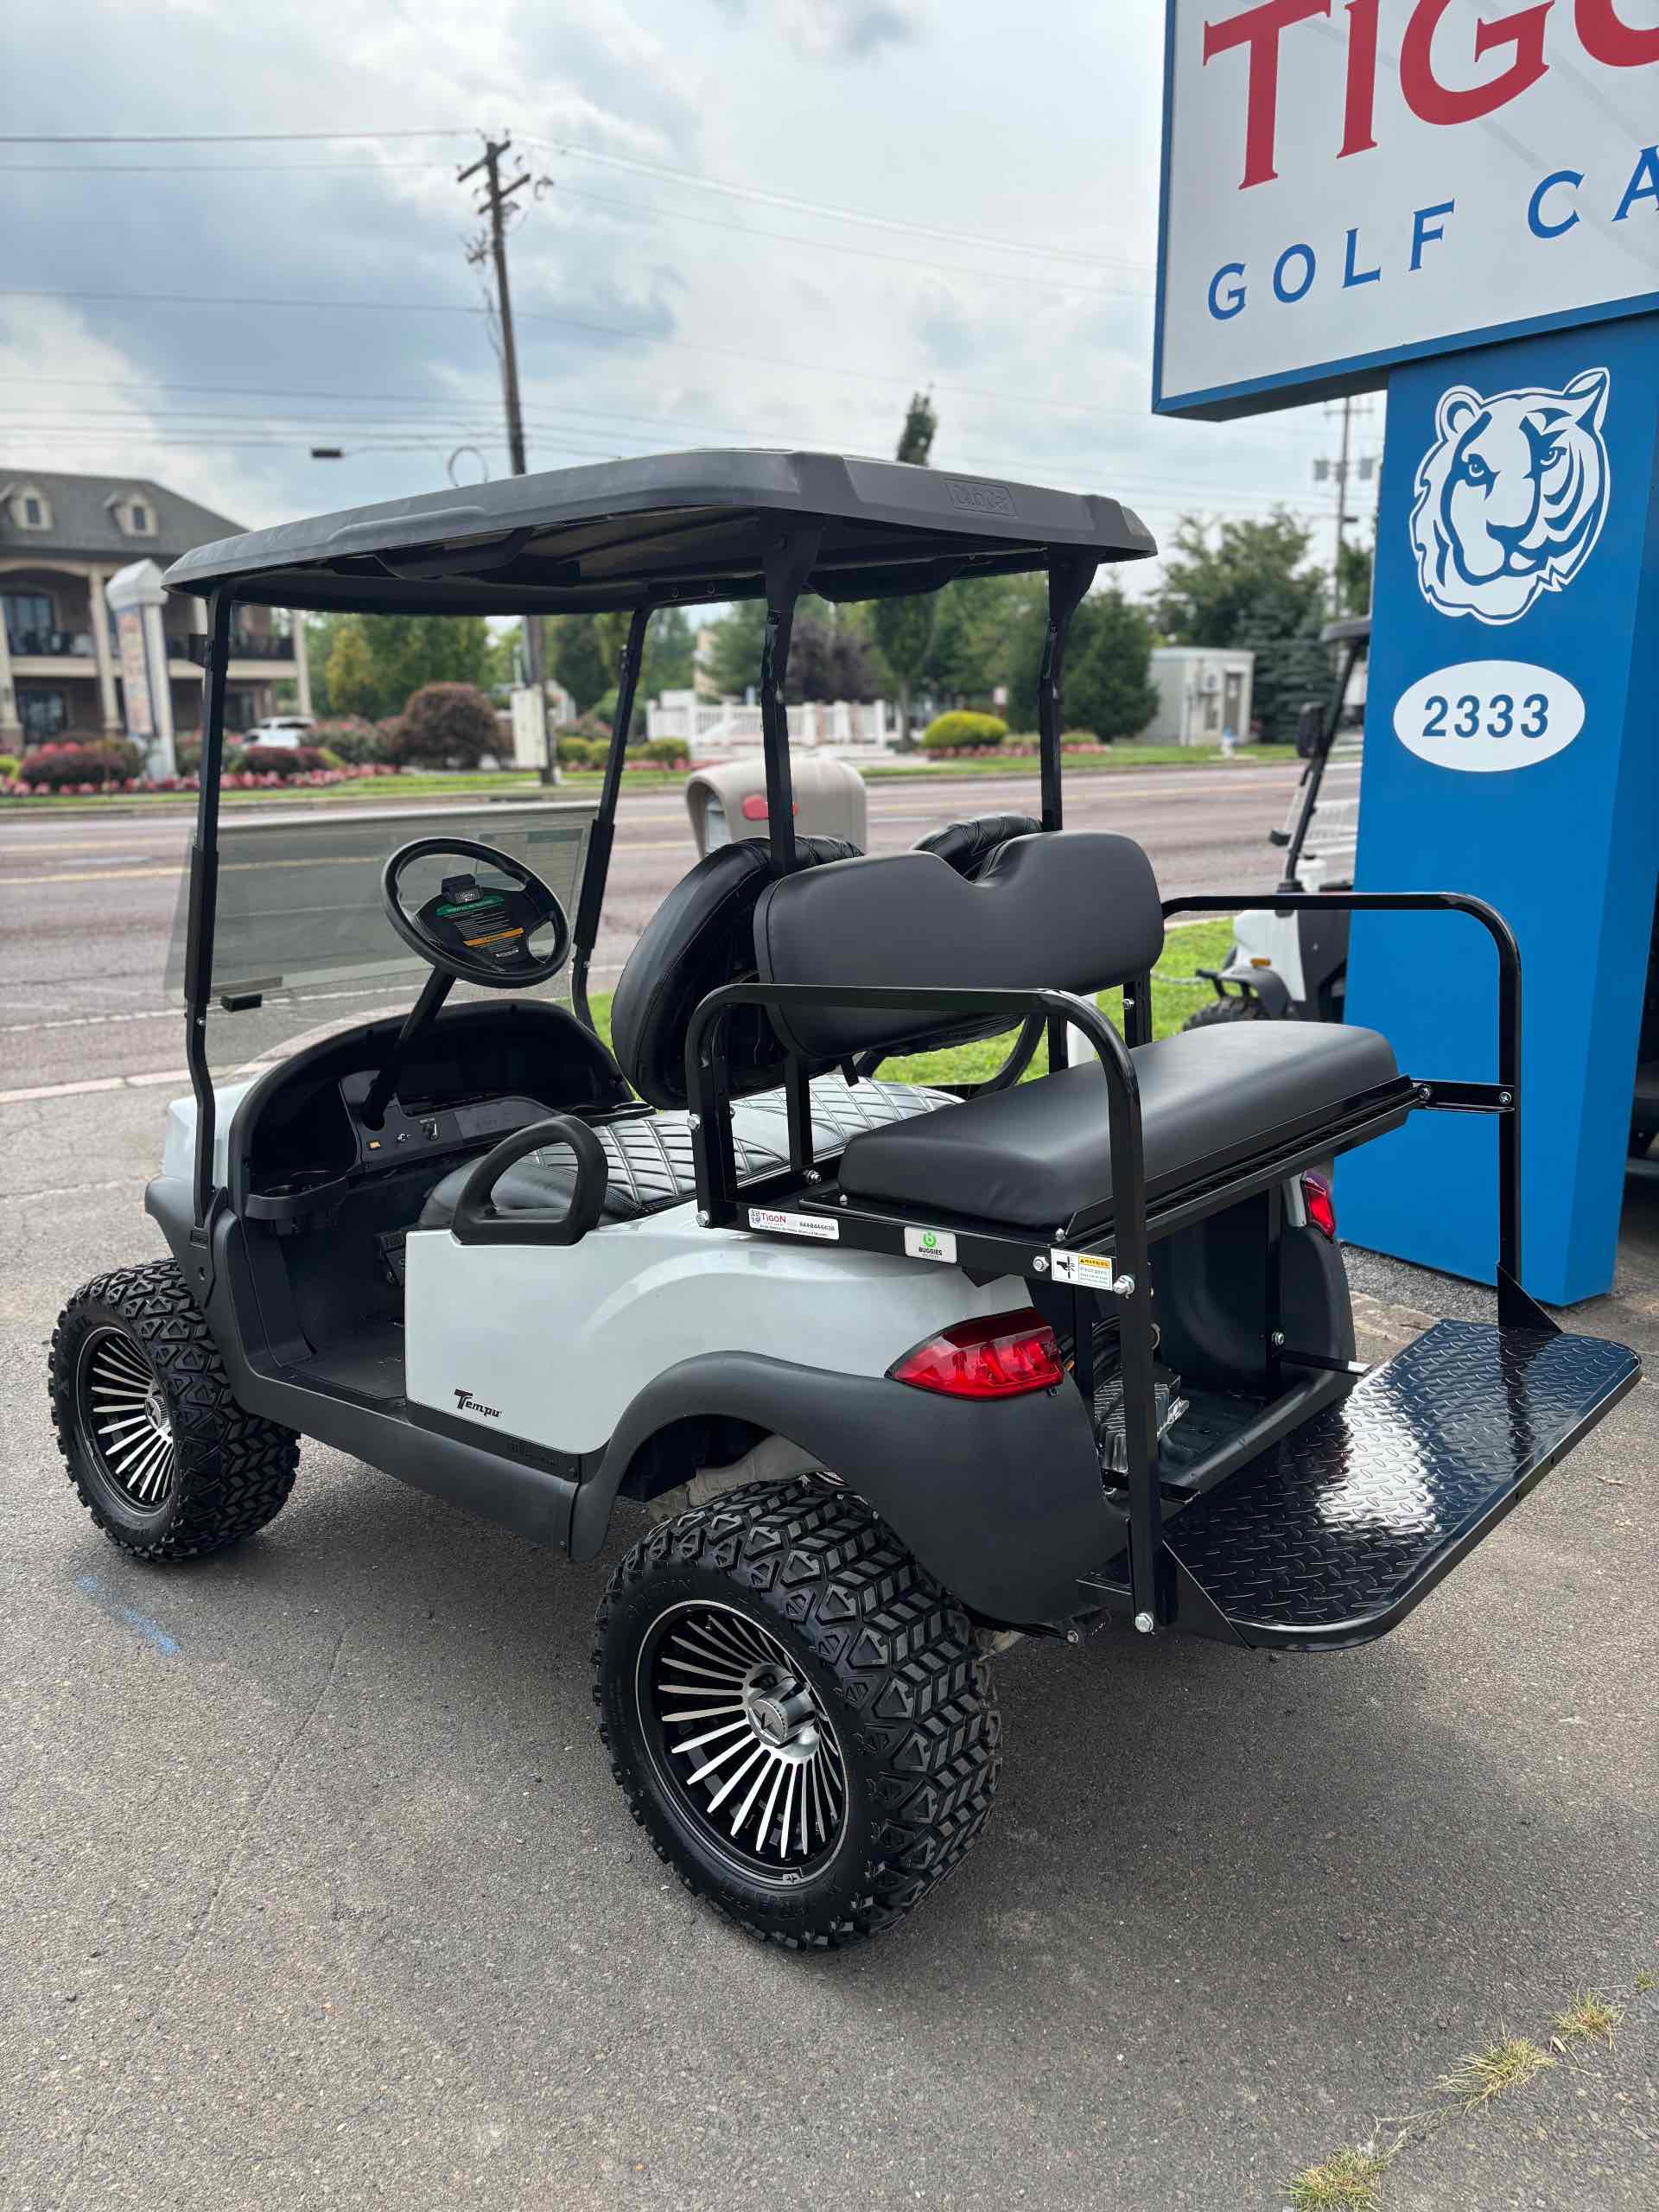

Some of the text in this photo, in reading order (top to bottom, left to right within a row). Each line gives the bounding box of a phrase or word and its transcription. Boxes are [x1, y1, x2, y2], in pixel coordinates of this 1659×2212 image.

[1207, 198, 1456, 321] GOLF
[1422, 693, 1549, 739] 2333
[918, 1246, 943, 1256] BUGGIES
